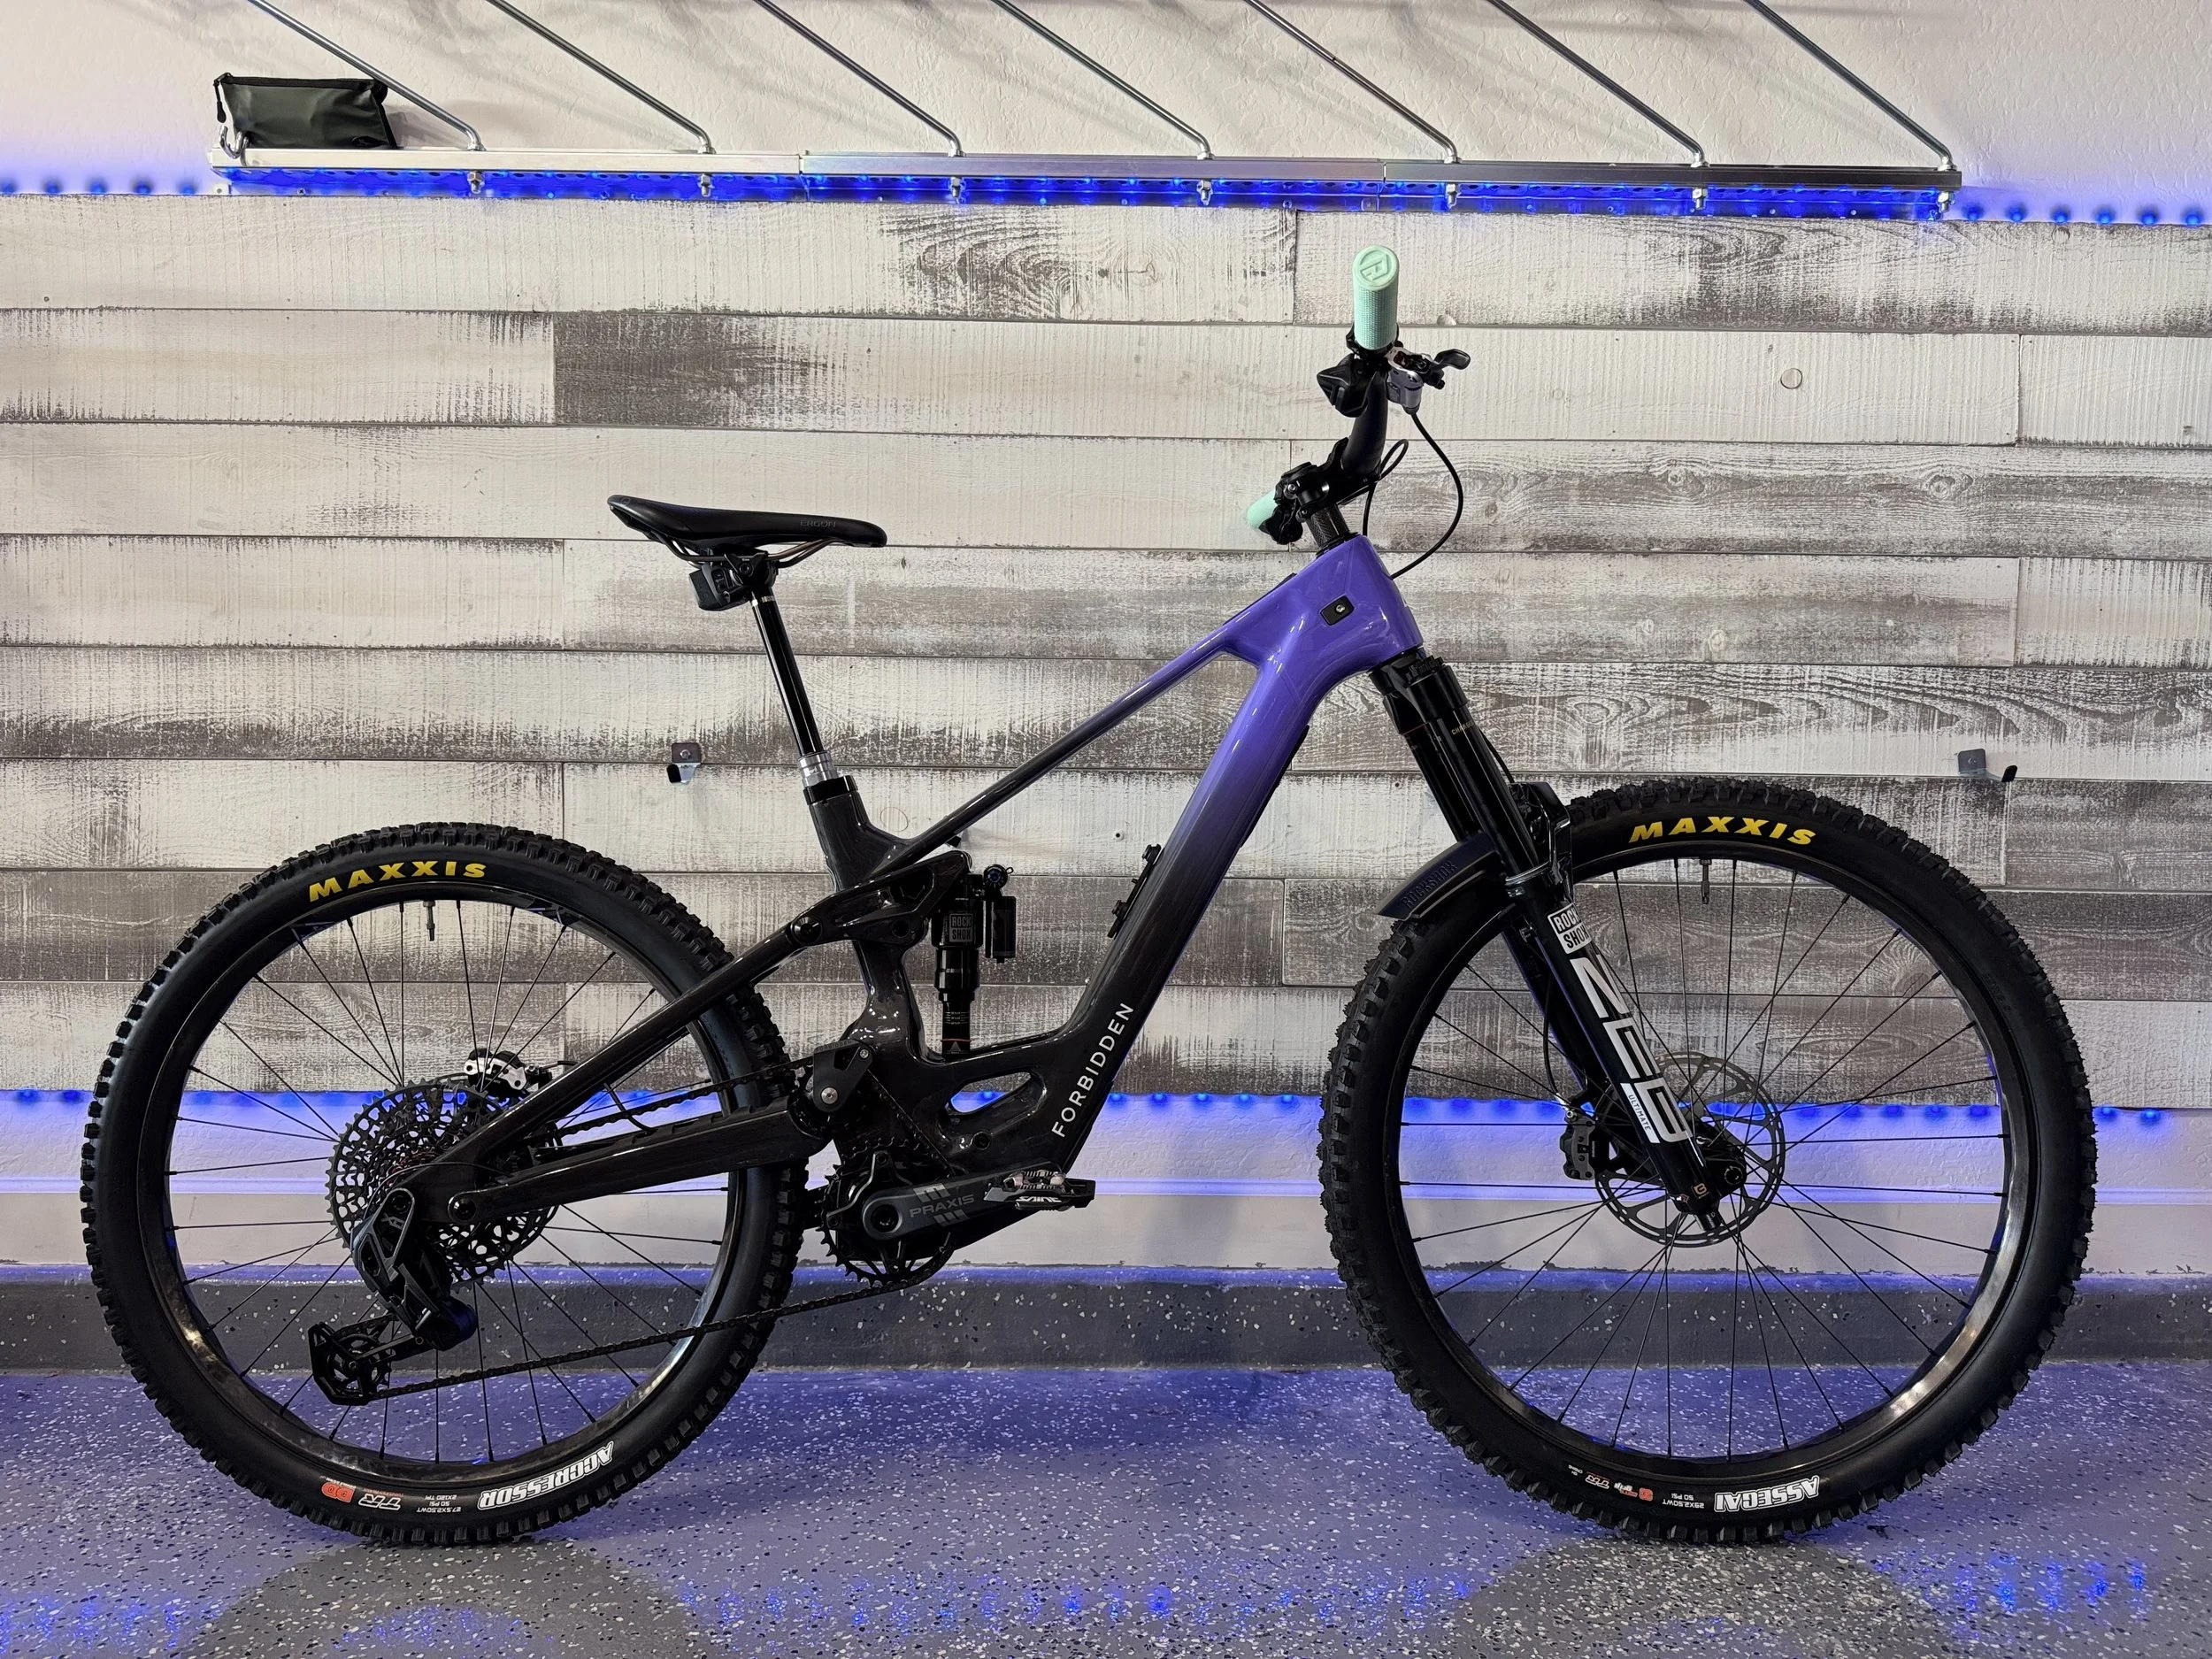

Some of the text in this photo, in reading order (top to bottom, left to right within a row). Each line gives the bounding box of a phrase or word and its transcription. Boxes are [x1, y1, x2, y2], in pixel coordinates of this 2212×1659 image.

[800, 519, 836, 528] ERGON
[1628, 816, 1816, 845] MAXXIS
[310, 861, 487, 902] MAXXIS
[1402, 858, 1459, 909] ROCKSHOX
[951, 916, 972, 927] ROCK
[1553, 904, 1582, 932] ROCK
[951, 929, 972, 941] SHOX
[1563, 925, 1590, 949] SHOX
[1051, 1002, 1133, 1138] FORBIDDEN
[1627, 1094, 1652, 1132] ULTIMATE
[910, 1194, 975, 1218] PRAXIS
[477, 1440, 614, 1510] AGGRESSOR
[358, 1494, 401, 1510] TR
[1714, 1475, 1820, 1512] ASSEGAI
